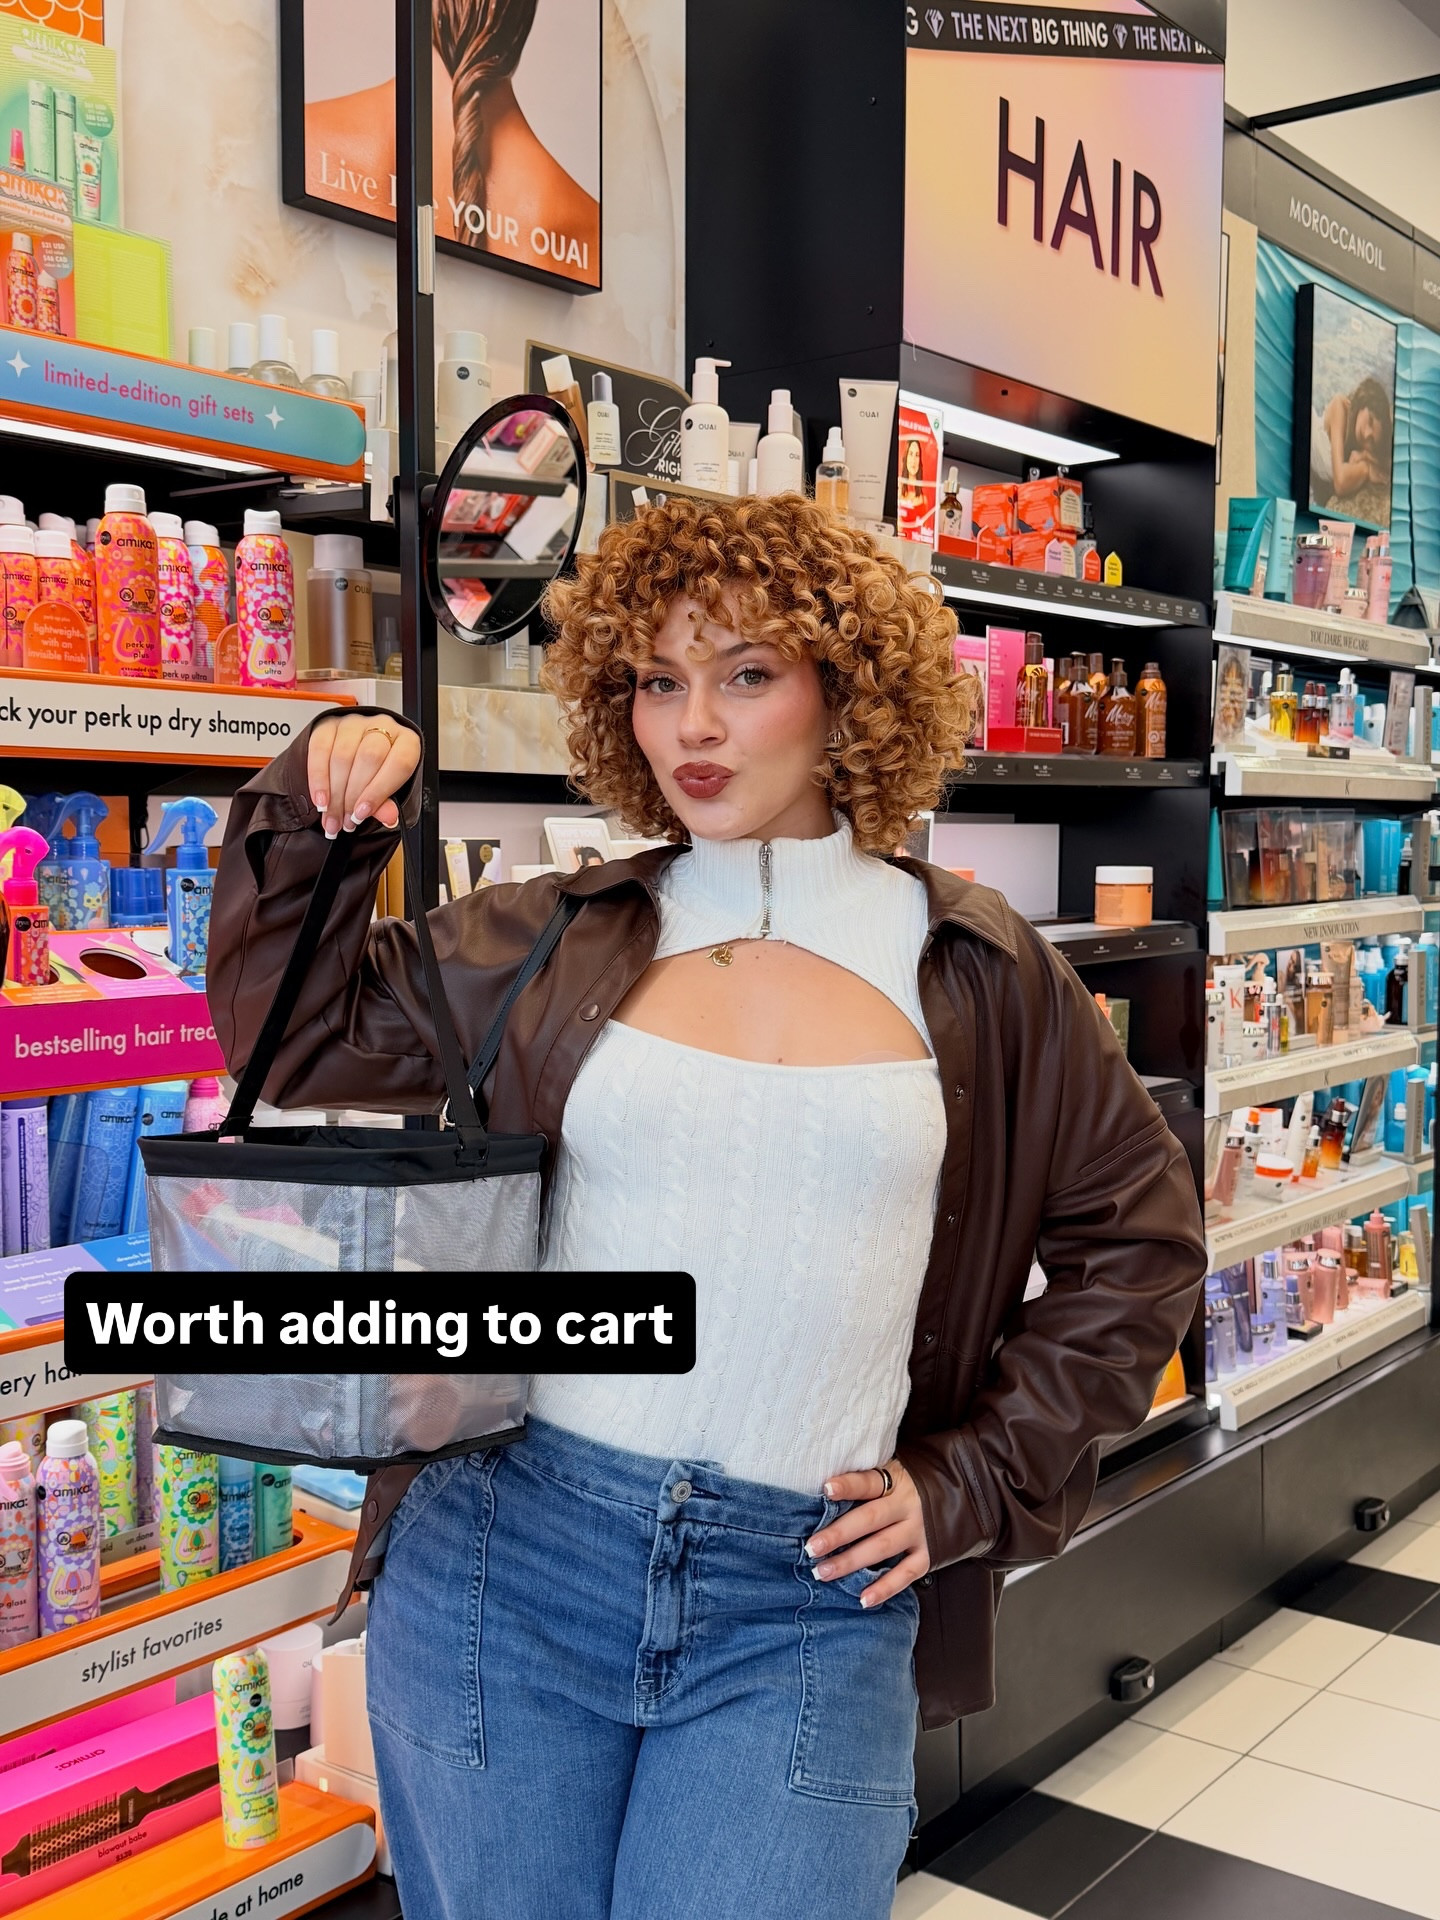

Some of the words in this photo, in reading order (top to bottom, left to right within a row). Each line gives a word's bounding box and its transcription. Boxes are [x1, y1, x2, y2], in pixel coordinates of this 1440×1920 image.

[951, 12, 983, 41] THE
[987, 16, 1027, 43] NEXT
[1032, 18, 1058, 45] BIG
[1062, 20, 1108, 48] THING
[1133, 25, 1157, 50] THE
[998, 95, 1164, 298] HAIR
[319, 151, 378, 200] Live
[447, 196, 519, 247] YOUR
[530, 227, 588, 270] OUAI
[1289, 196, 1386, 271] MOROCCANOIL
[44, 360, 182, 409] limited-edition
[189, 395, 218, 418] gift
[223, 404, 255, 424] sets
[859, 410, 880, 419] OUAI
[117, 536, 154, 550] amika:
[250, 562, 287, 573] amika:
[2, 573, 32, 582] amika:
[40, 576, 68, 584] amika:
[41, 637, 59, 647] with
[126, 641, 144, 649] perk
[146, 642, 155, 650] up
[64, 651, 86, 663] finish
[133, 651, 149, 659] plus
[258, 658, 275, 666] perk
[162, 669, 178, 679] perk
[191, 672, 208, 680] ultra
[28, 706, 77, 729] your
[85, 704, 132, 732] perk
[138, 712, 162, 736] up
[169, 707, 202, 738] dry
[208, 710, 291, 741] shampoo
[1304, 926, 1319, 938] NEW
[15, 1028, 126, 1059] bestselling
[135, 1023, 173, 1048] hair
[0, 1373, 36, 1396] ery
[45, 1361, 83, 1384] ha
[53, 1486, 92, 1498] amika:
[55, 1588, 77, 1596] rising
[80, 1585, 92, 1593] star
[81, 1647, 136, 1683] stylist
[142, 1617, 223, 1660] favorites
[98, 1840, 126, 1858] blowout
[128, 1832, 147, 1844] babe
[235, 1895, 252, 1917] at
[259, 1873, 303, 1907] home
